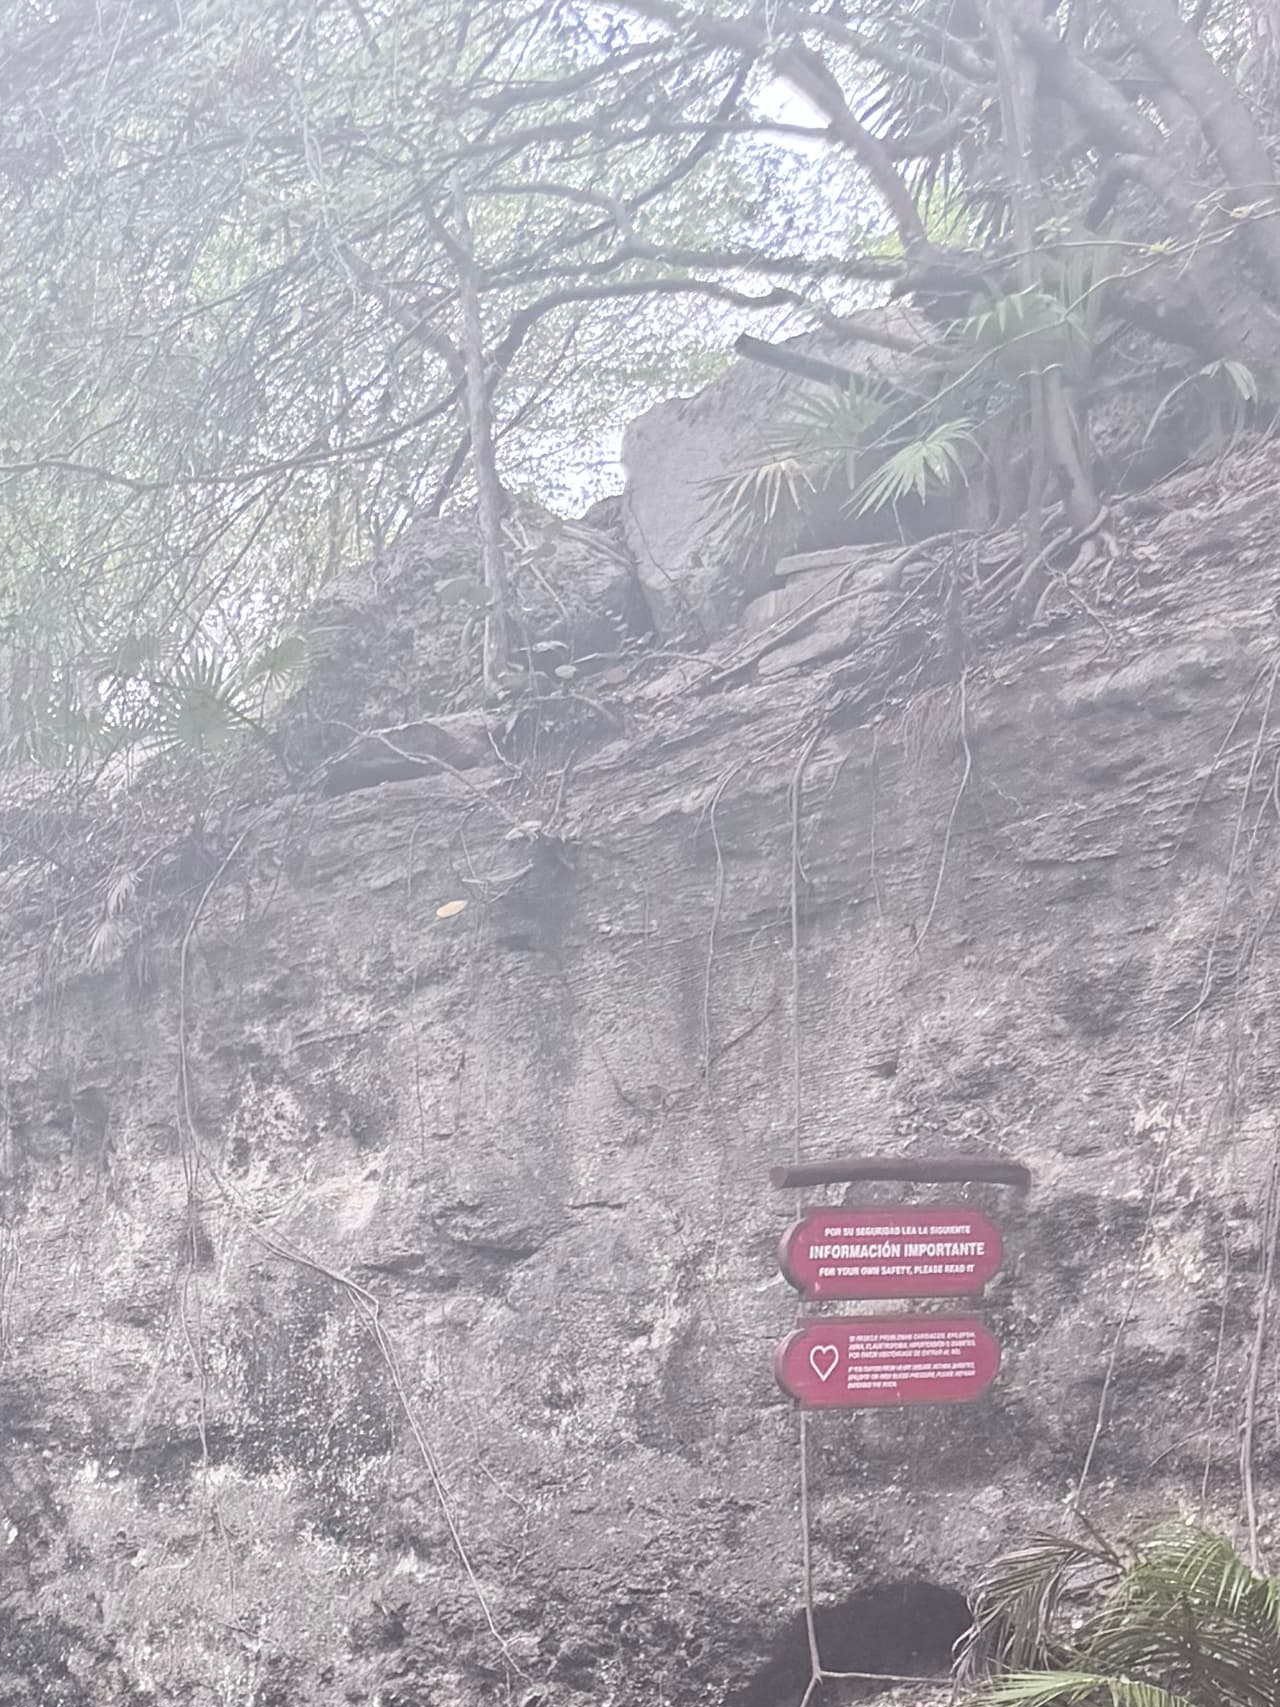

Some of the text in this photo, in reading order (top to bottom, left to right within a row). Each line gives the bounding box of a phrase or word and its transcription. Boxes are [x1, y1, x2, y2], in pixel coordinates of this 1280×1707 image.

[902, 1226, 917, 1235] LEA
[918, 1226, 928, 1235] LA
[809, 1240, 985, 1259] INFORMACIÓN IMPORTANTE
[819, 1267, 836, 1277] FOR
[837, 1266, 859, 1276] YOUR
[861, 1266, 879, 1275] OWN
[914, 1264, 943, 1274] PLEASE
[944, 1264, 965, 1273] READ
[966, 1264, 975, 1272] IT
